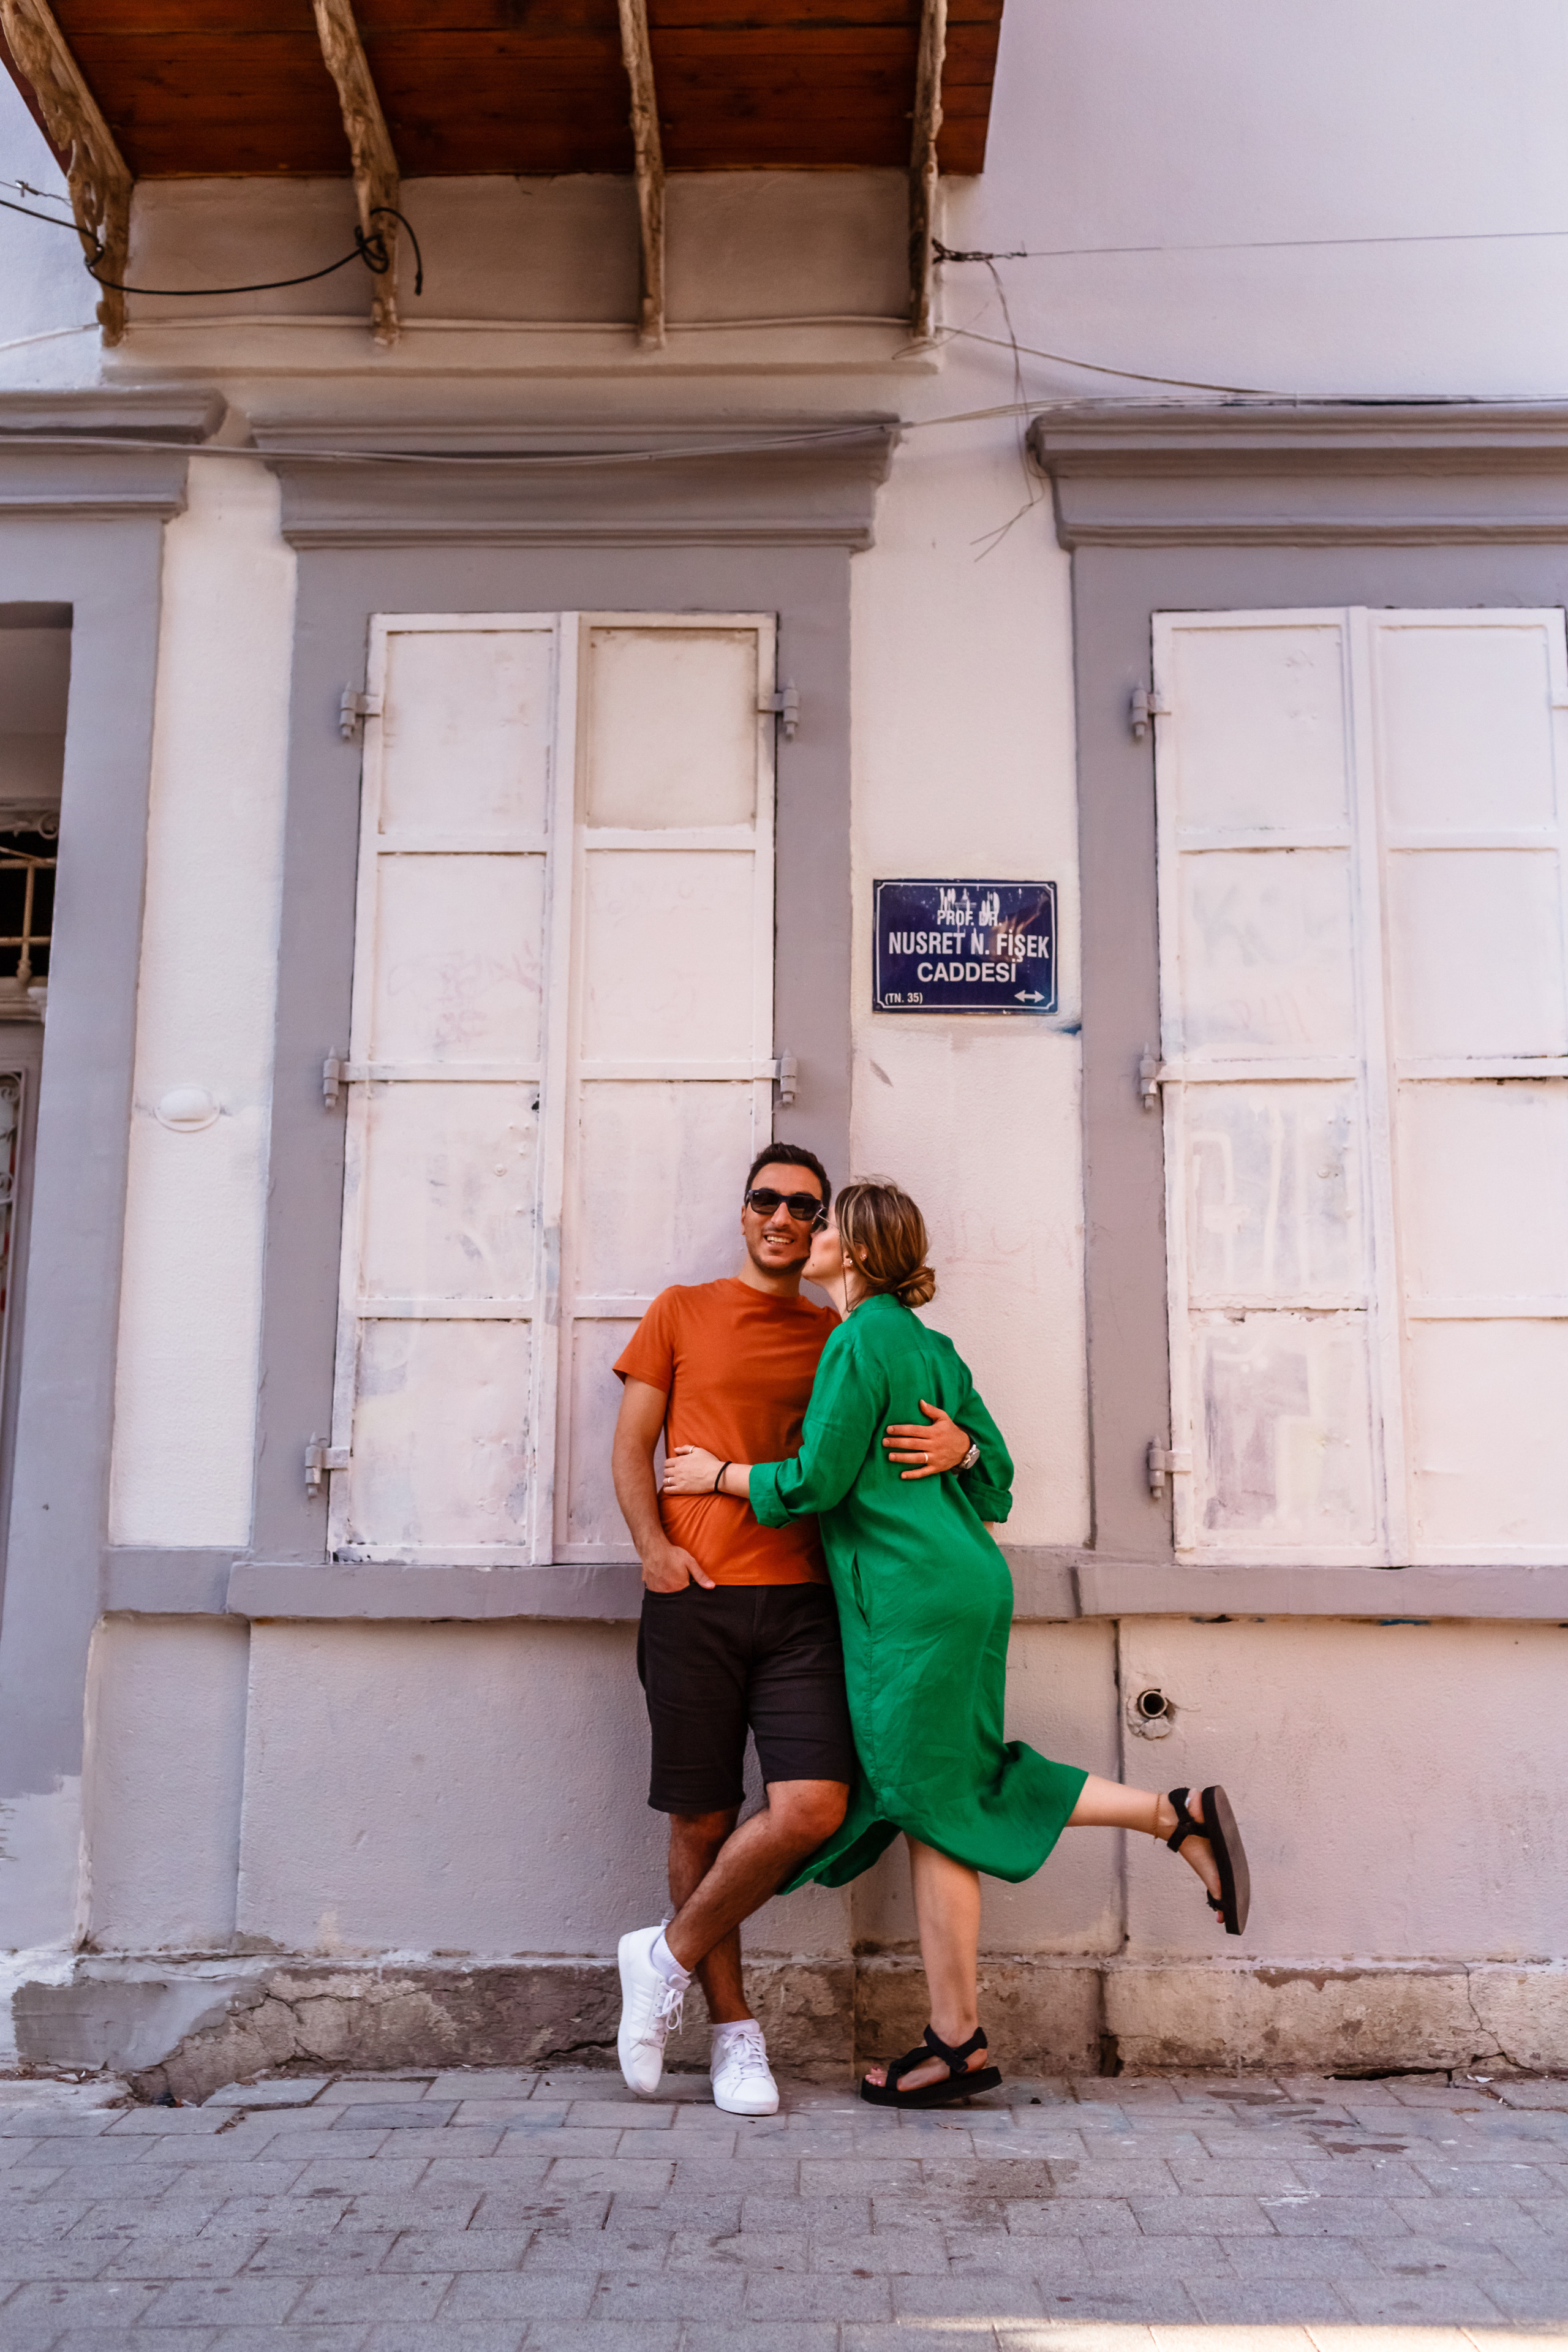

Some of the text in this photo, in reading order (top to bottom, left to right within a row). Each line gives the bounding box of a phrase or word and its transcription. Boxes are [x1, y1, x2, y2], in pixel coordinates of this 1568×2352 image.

[937, 910, 1002, 927] PROF. DR.
[889, 929, 1049, 962] NUSRET N. FİŞEK
[917, 958, 1016, 982] CADDESİ
[884, 993, 923, 1005] (TN. 35)
